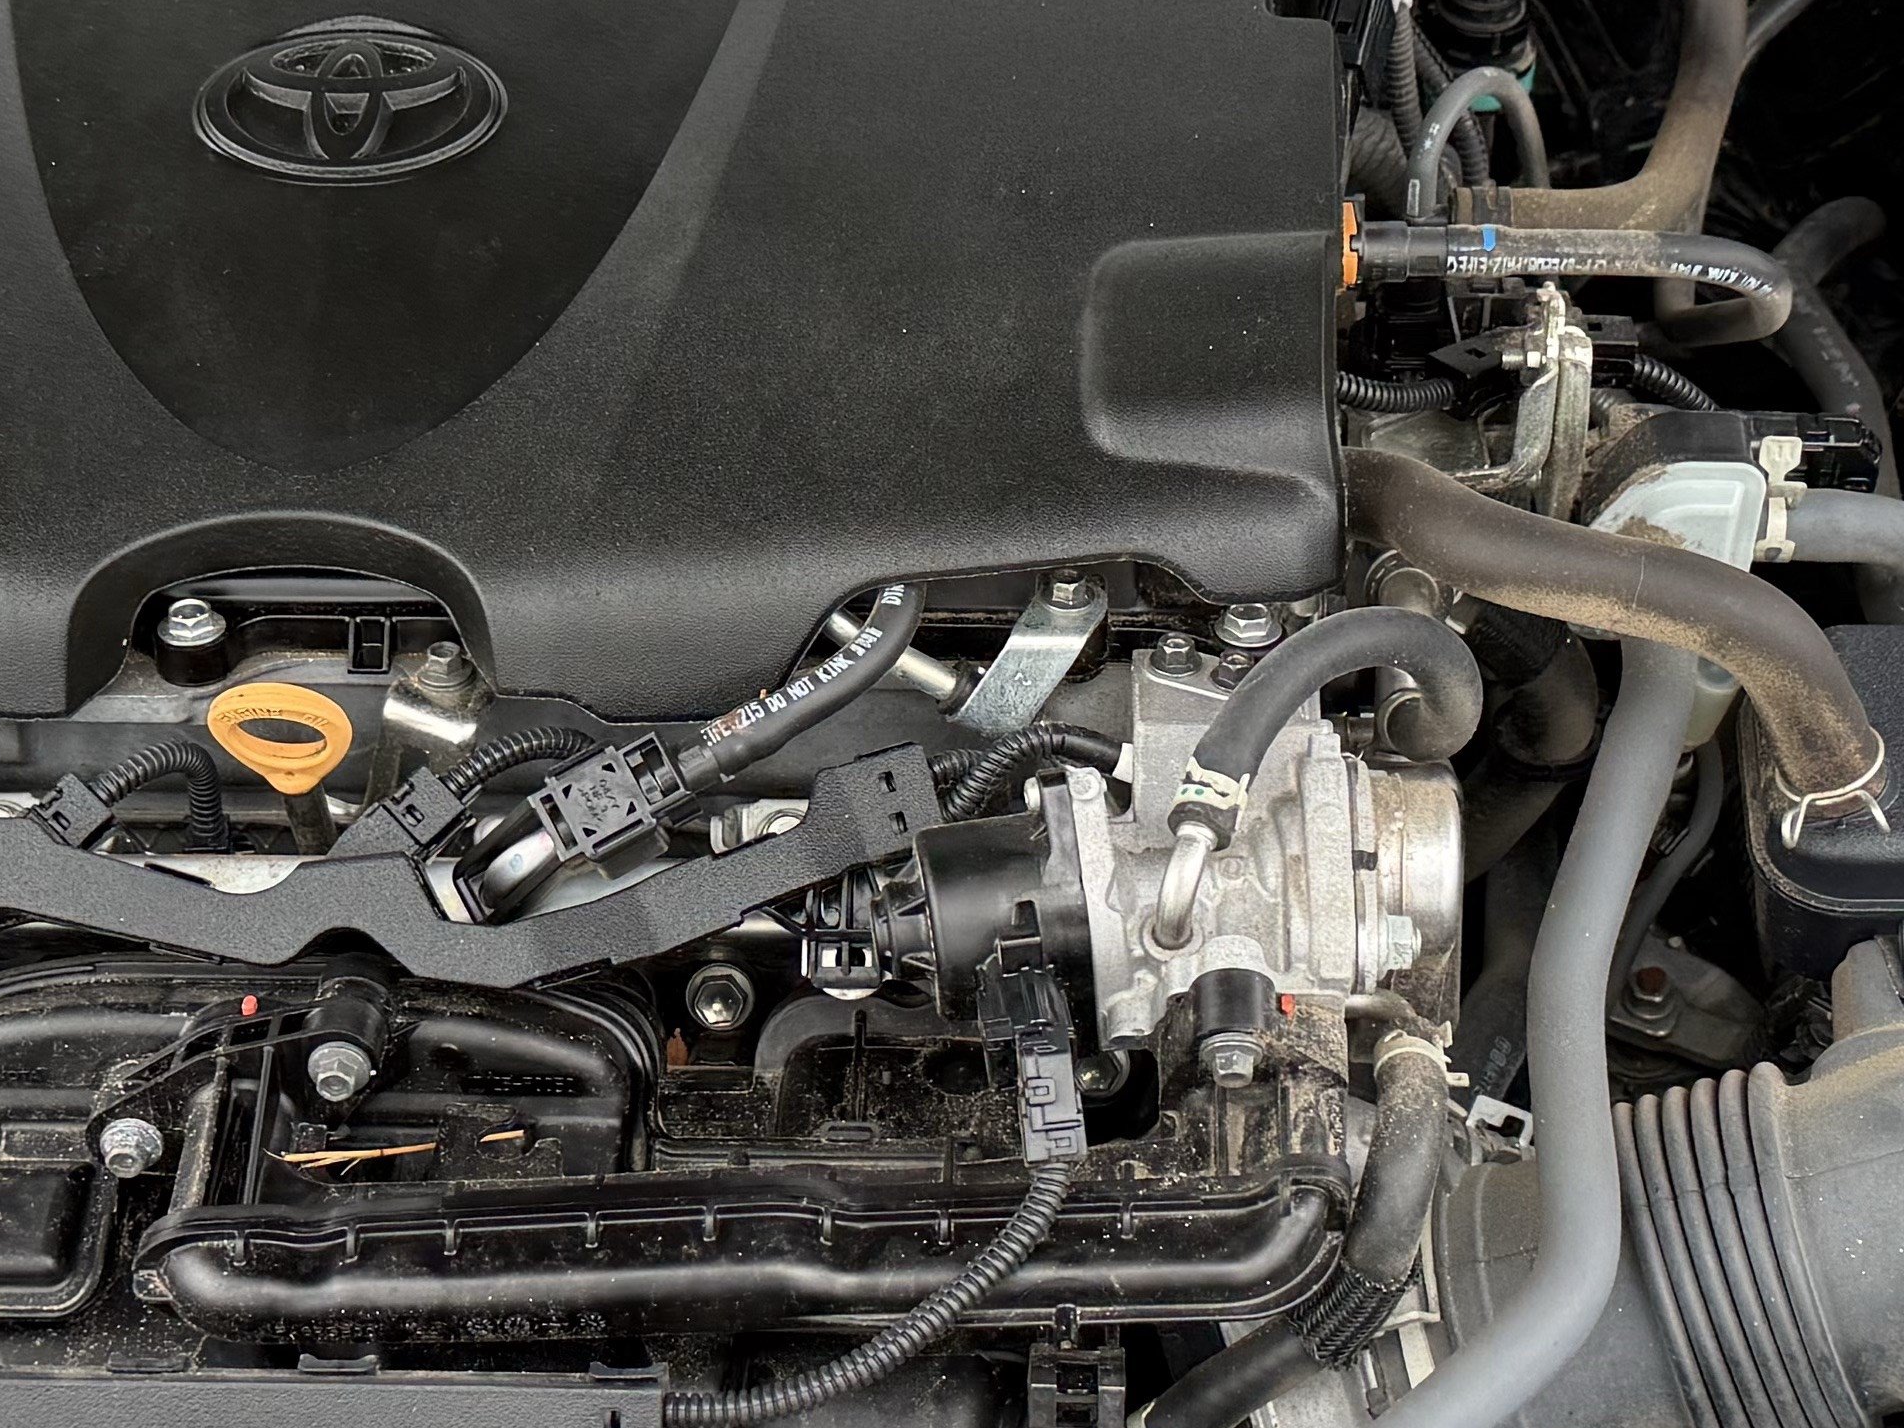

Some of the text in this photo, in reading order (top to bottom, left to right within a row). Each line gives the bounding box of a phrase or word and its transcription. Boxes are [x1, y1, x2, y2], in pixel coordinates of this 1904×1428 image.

[764, 653, 855, 713] DO NOT KINK
